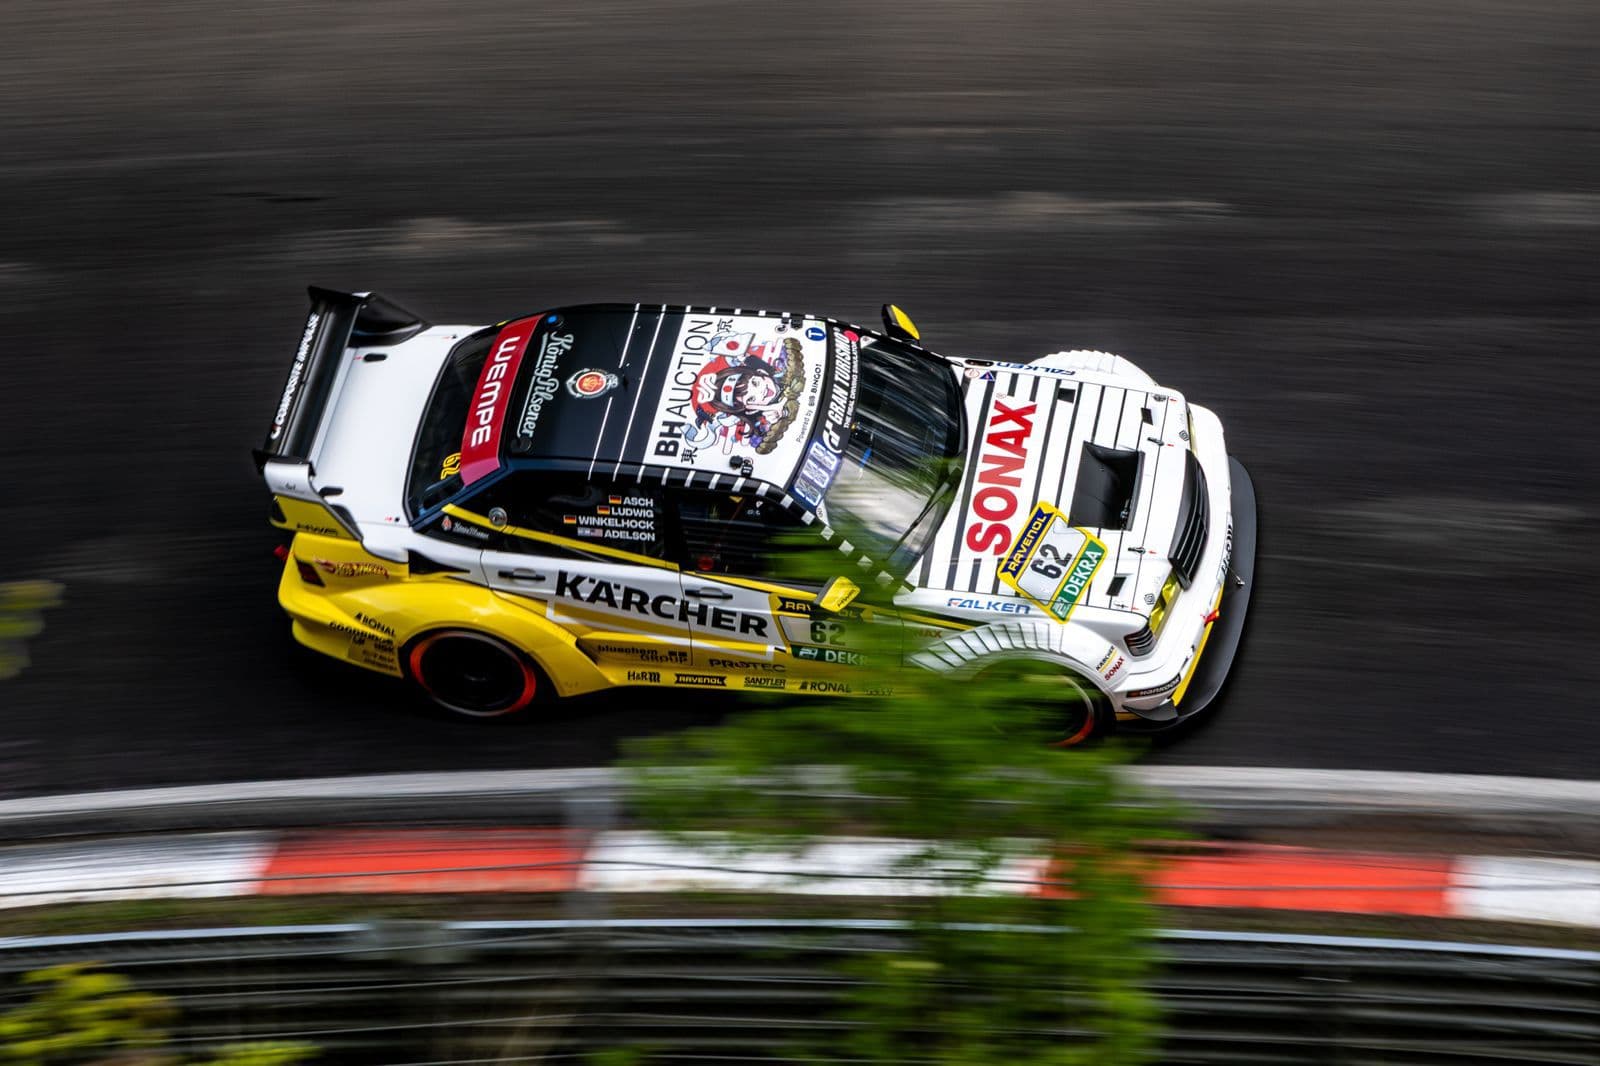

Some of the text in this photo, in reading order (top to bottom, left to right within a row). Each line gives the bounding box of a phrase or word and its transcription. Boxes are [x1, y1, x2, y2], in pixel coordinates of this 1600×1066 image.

[834, 331, 852, 387] TURISMO
[275, 361, 303, 425] COMPOSITE
[471, 336, 520, 447] WEMPE
[654, 320, 713, 457] BH AUCTION
[828, 384, 849, 425] GRAN
[966, 400, 1038, 556] SONAX
[611, 506, 655, 518] LUDWIG
[623, 496, 654, 507] ASCH
[578, 515, 656, 530] WINKELHOCK
[604, 529, 656, 542] ADELSON
[1008, 515, 1047, 571] RAVENOL
[1030, 544, 1073, 579] 62
[1063, 550, 1102, 596] DEKRA
[555, 569, 769, 638] KÄRCHER
[947, 597, 1031, 614] FALKEN
[810, 620, 847, 646] 62
[708, 658, 787, 673] PROTEC
[1104, 656, 1125, 681] SONAX
[678, 675, 723, 685] RAVENOL
[744, 676, 786, 687] SANDTLER
[810, 681, 851, 693] RONAL
